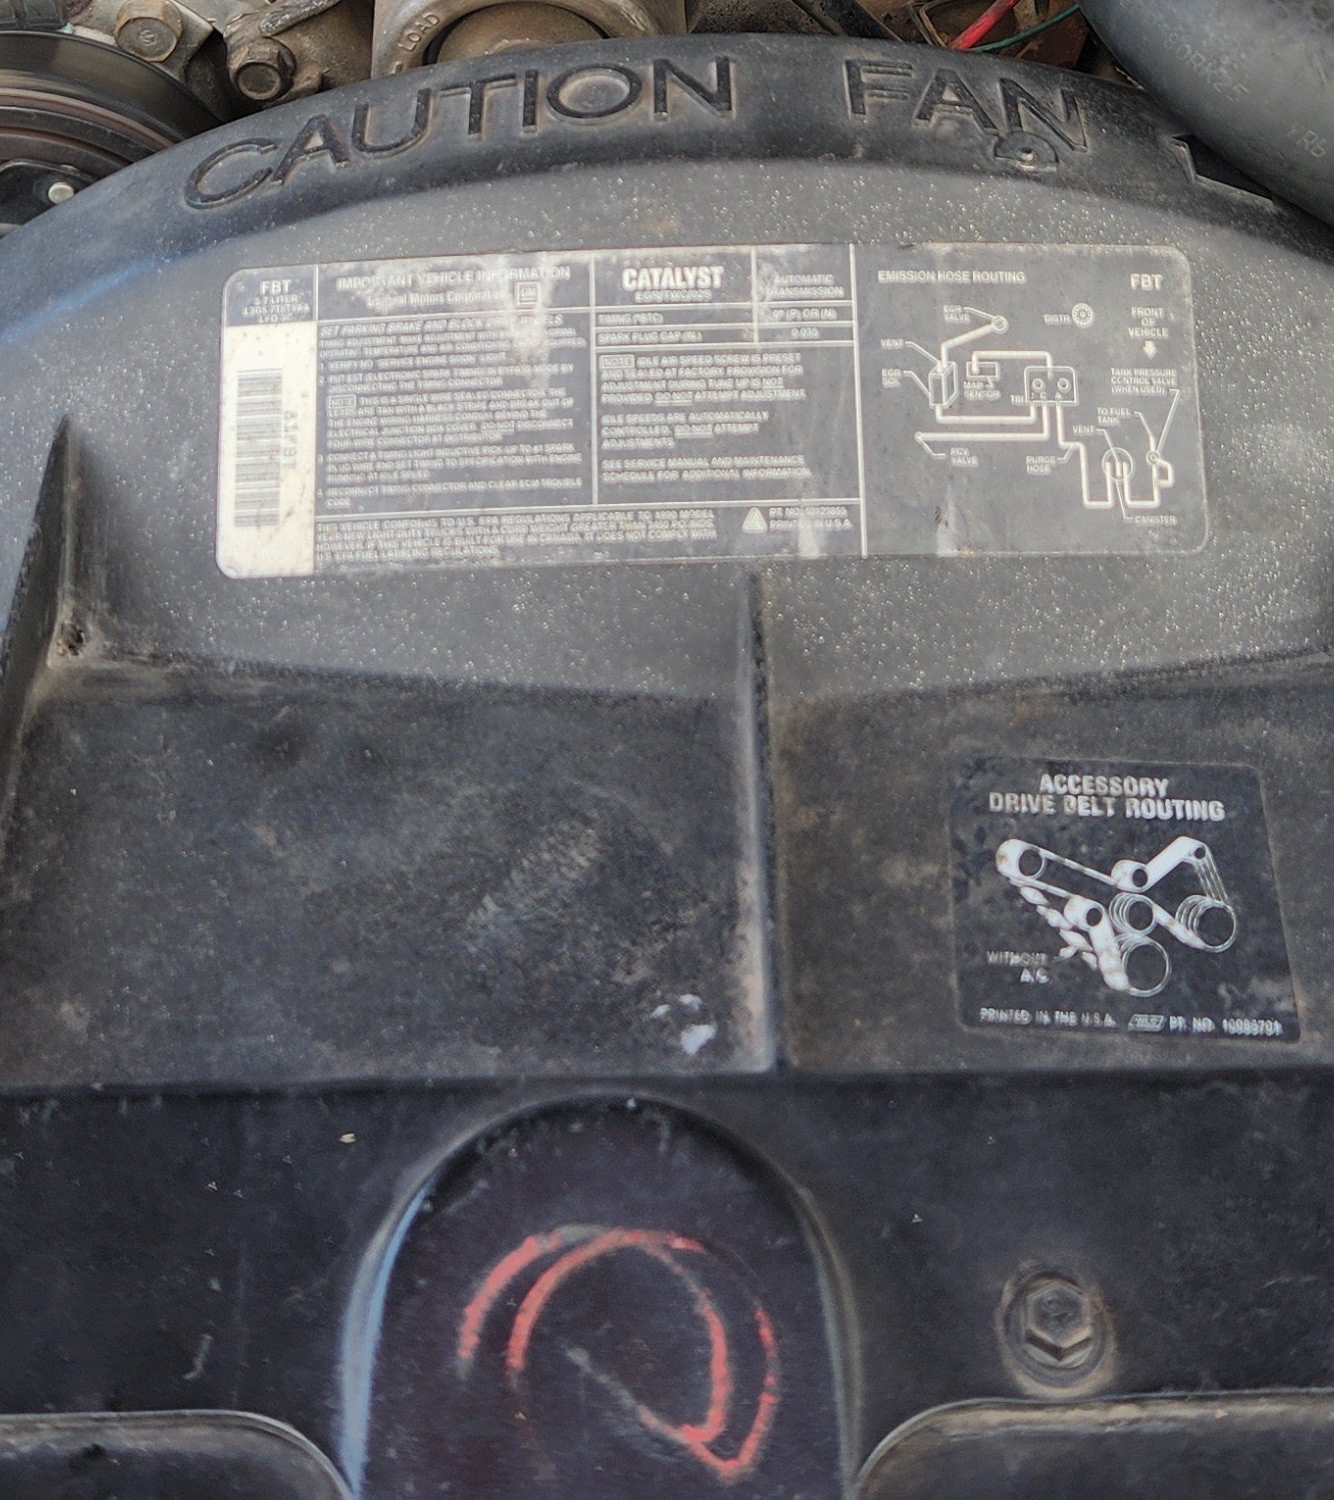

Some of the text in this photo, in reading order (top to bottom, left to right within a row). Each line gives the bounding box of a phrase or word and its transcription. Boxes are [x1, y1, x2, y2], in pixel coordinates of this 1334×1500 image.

[396, 12, 441, 53] LOAD
[183, 55, 1094, 210] CAUTION FAN
[621, 266, 724, 292] CATALYST
[773, 274, 834, 286] AUTOMATIC
[877, 270, 1028, 284] EMISSION HOSE ROUTING
[1130, 273, 1164, 291] FBT
[260, 277, 293, 296] FBT
[766, 285, 845, 300] TRANSMISSION
[409, 291, 445, 305] Motors
[1131, 306, 1165, 318] FRONT
[597, 313, 632, 326] TIMING
[1140, 317, 1157, 327] OF
[1128, 327, 1170, 340] VEHICLE
[1110, 367, 1178, 378] TANK PRESSURE
[1110, 377, 1178, 387] CONTROL VALVE
[694, 389, 739, 402] ATTEMPT
[963, 389, 1002, 401] SENSOR
[688, 410, 770, 424] AUTOMATICALLY
[1097, 407, 1131, 417] TO FUEL
[1097, 416, 1120, 426] TANK
[714, 422, 760, 435] ATTEMPT
[1072, 425, 1096, 437] VENT
[623, 458, 667, 470] SERVICE
[667, 457, 709, 469] MANUAL
[951, 456, 979, 467] VALVE
[1026, 455, 1056, 466] PURGE
[1026, 465, 1052, 477] HOSE
[1134, 515, 1179, 527] CANISTER
[1039, 773, 1170, 799] ACCESSORY
[988, 790, 1226, 822] DRIVE BELT ROUTING
[986, 950, 1049, 967] WITHOUT
[979, 1006, 1033, 1026] PRINTED
[1035, 1009, 1052, 1025] IN
[1053, 1009, 1079, 1027] THE
